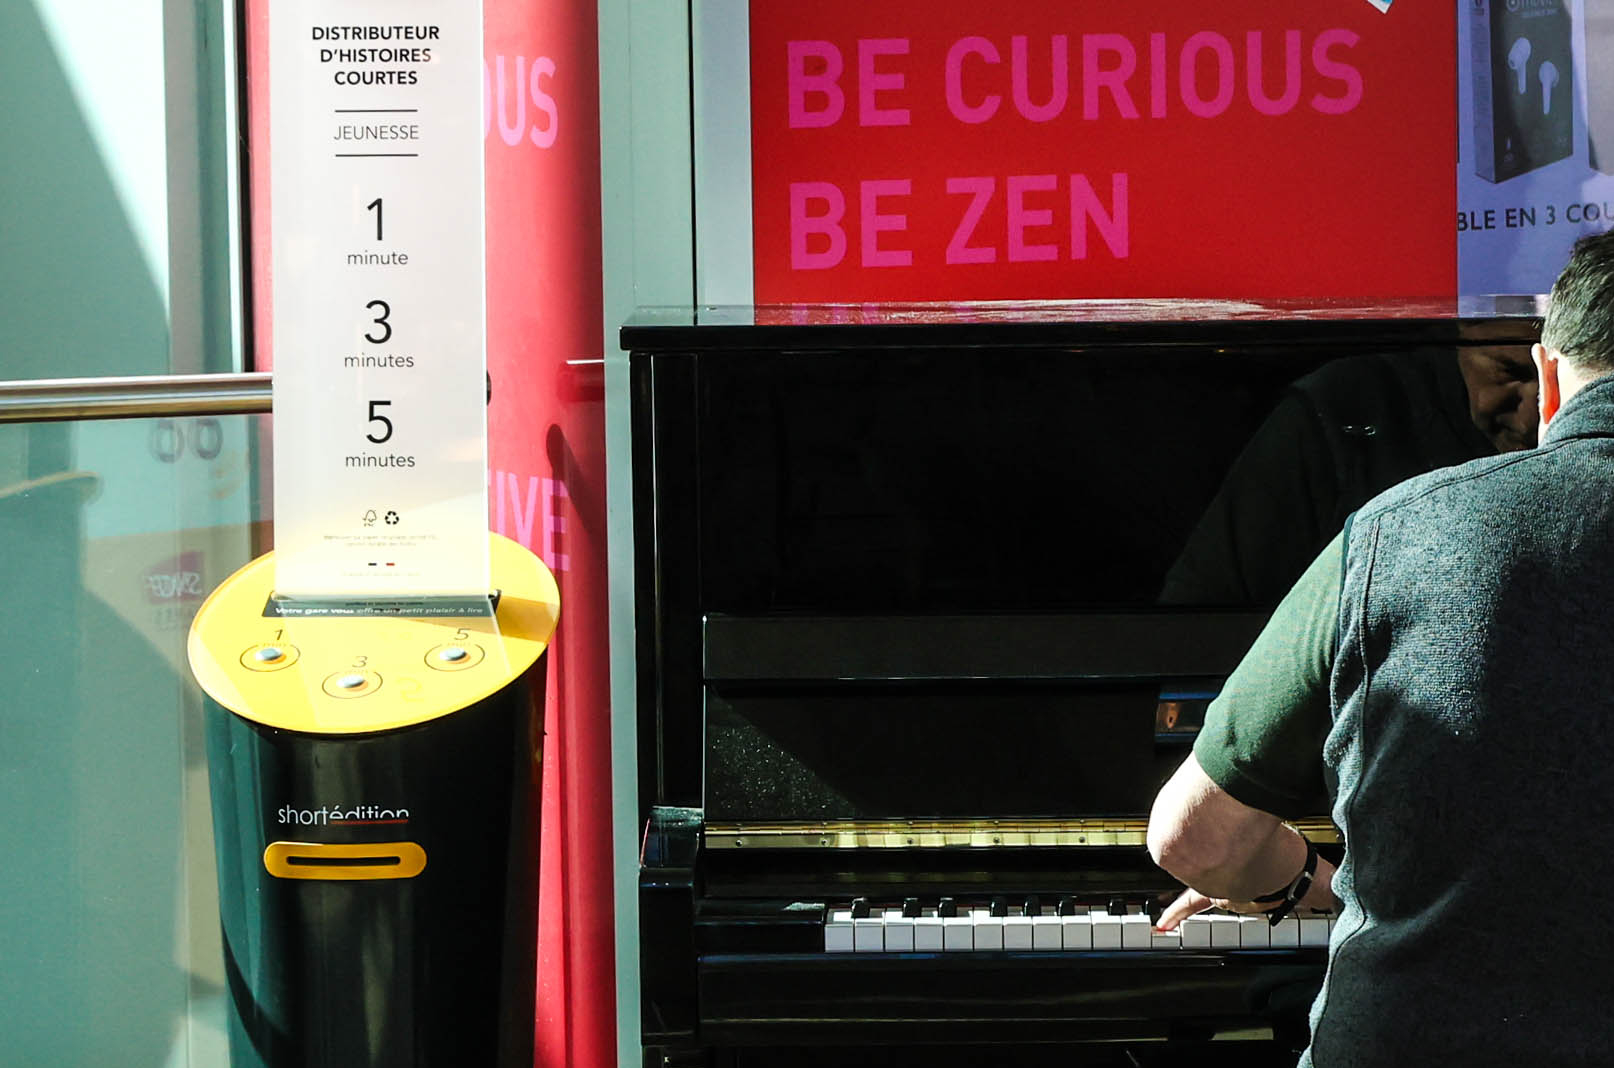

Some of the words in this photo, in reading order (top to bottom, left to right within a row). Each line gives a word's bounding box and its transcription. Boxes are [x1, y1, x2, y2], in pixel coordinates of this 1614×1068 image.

[312, 25, 440, 41] DISTRIBUTEUR
[320, 47, 432, 63] D'HISTOIRES
[334, 70, 418, 86] COURTES
[788, 39, 911, 129] BE
[945, 28, 1363, 124] CURIOUS
[334, 125, 419, 141] JEUNESSE
[366, 198, 383, 241] 1
[789, 179, 913, 271] BE
[945, 172, 1130, 265] ZEN
[1505, 207, 1536, 228] EN
[1546, 205, 1556, 225] 3
[347, 250, 409, 265] minute
[365, 300, 392, 344] 3
[344, 352, 415, 368] minutes
[366, 400, 393, 443] 5
[345, 452, 416, 468] minutes
[454, 628, 471, 641] 5
[352, 656, 368, 668] 3
